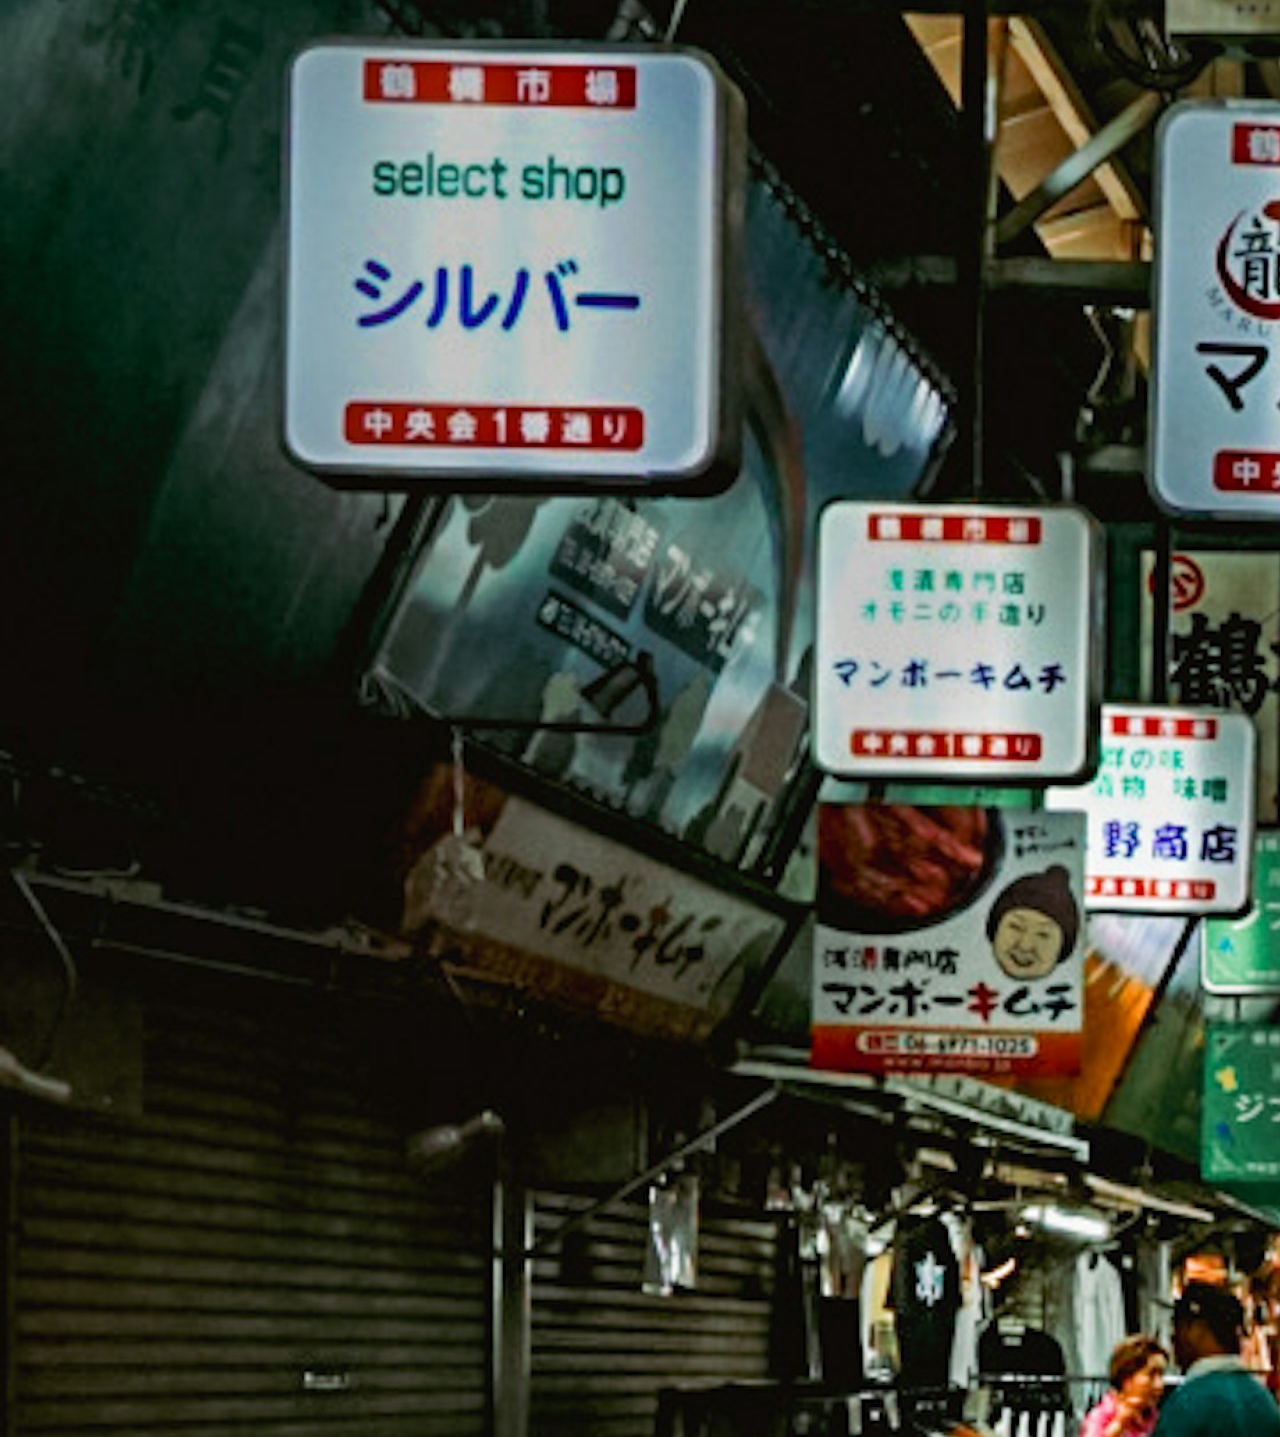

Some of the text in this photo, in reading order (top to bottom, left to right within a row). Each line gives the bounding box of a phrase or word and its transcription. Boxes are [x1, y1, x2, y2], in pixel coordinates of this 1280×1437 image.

[380, 63, 619, 105] 鶴橋市場
[373, 152, 626, 208] select shop
[355, 260, 640, 332] シルバー
[364, 409, 628, 444] 中央会1番通り
[833, 657, 1067, 694] マンボーキムチ
[821, 978, 1077, 1022] マンボーキムチ
